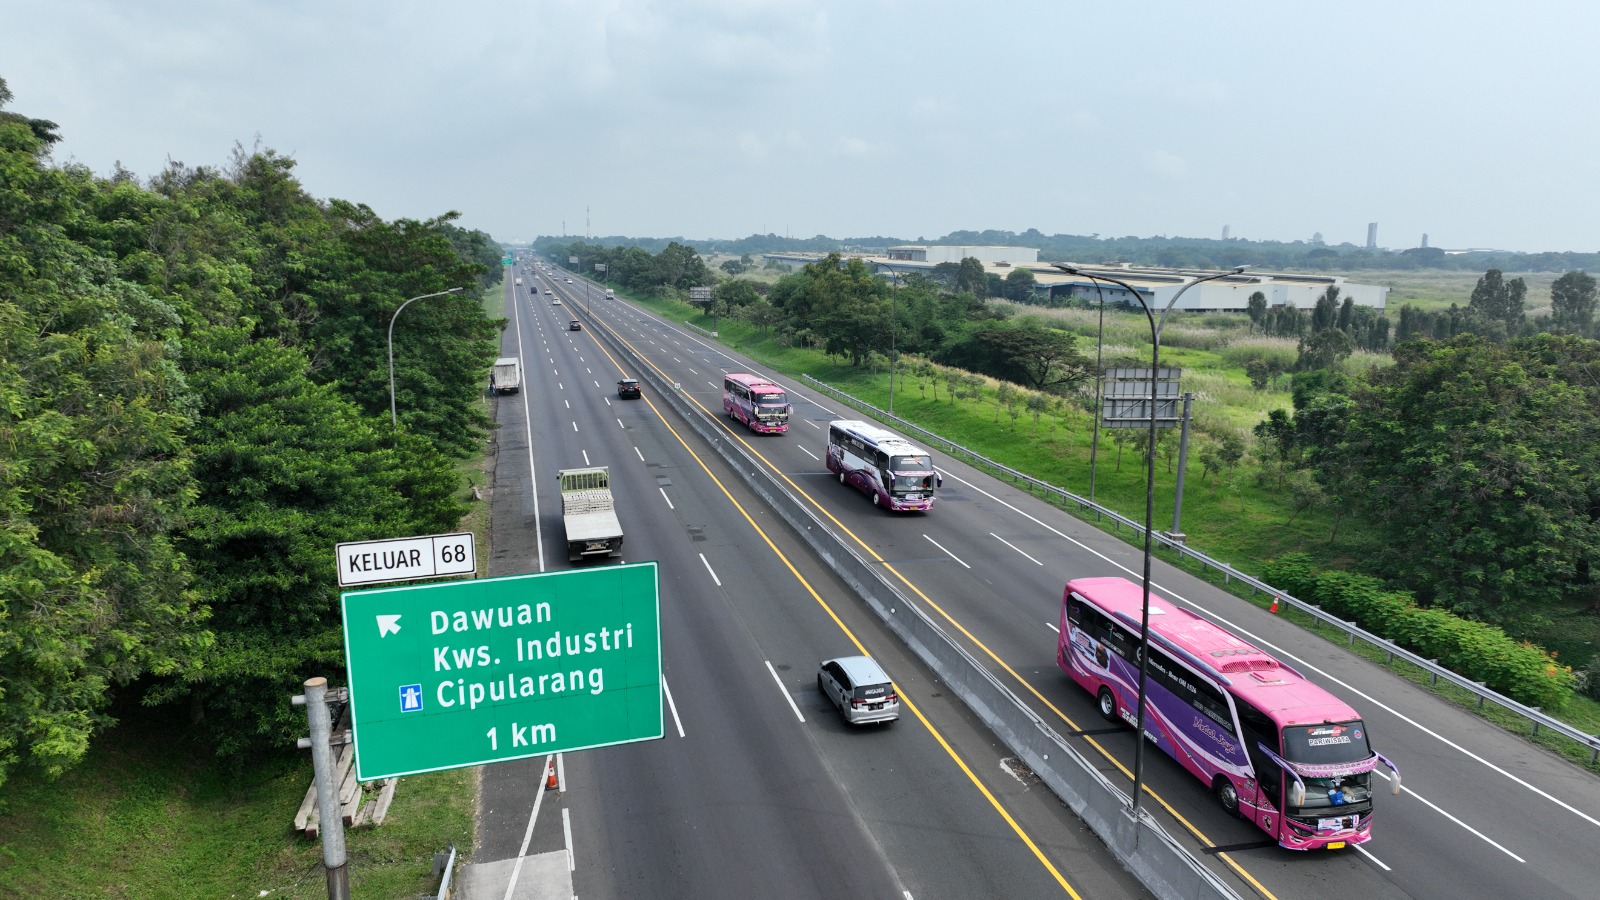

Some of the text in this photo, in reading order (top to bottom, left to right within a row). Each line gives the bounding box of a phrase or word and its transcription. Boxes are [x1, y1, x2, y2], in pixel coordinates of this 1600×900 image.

[350, 549, 421, 573] KELUAR
[442, 545, 466, 564] 68
[431, 602, 551, 635] Dawuan
[433, 622, 633, 672] Kws. Industri
[436, 668, 604, 710] Cipularang
[486, 722, 556, 751] 1 km
[1308, 735, 1351, 747] PARIWISATA
